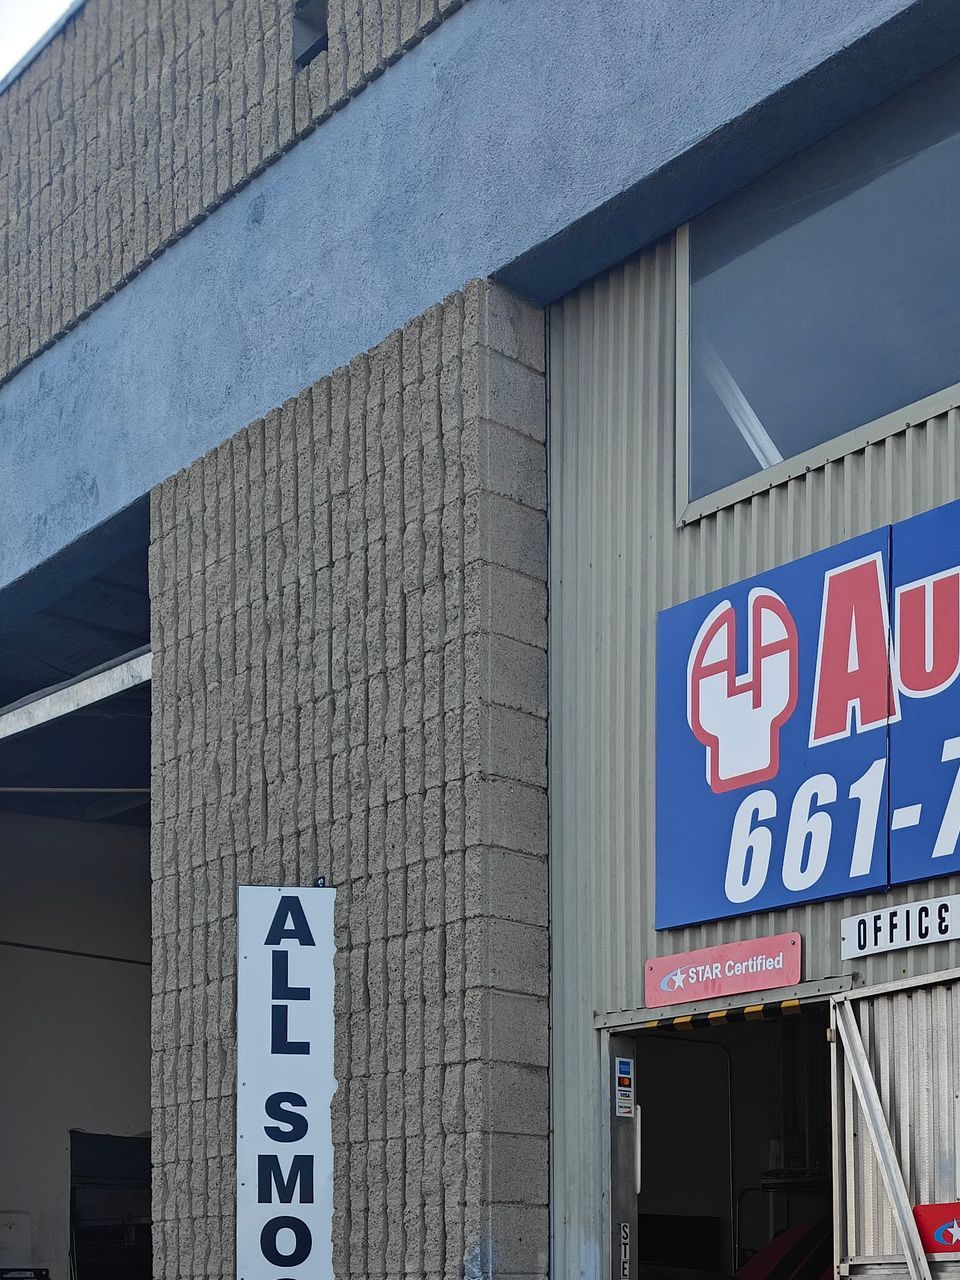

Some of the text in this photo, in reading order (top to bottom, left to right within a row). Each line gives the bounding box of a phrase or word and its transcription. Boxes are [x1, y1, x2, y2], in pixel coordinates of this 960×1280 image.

[857, 902, 950, 951] OFFICE
[263, 895, 317, 1056] ALL
[688, 951, 784, 984] STAR Certified
